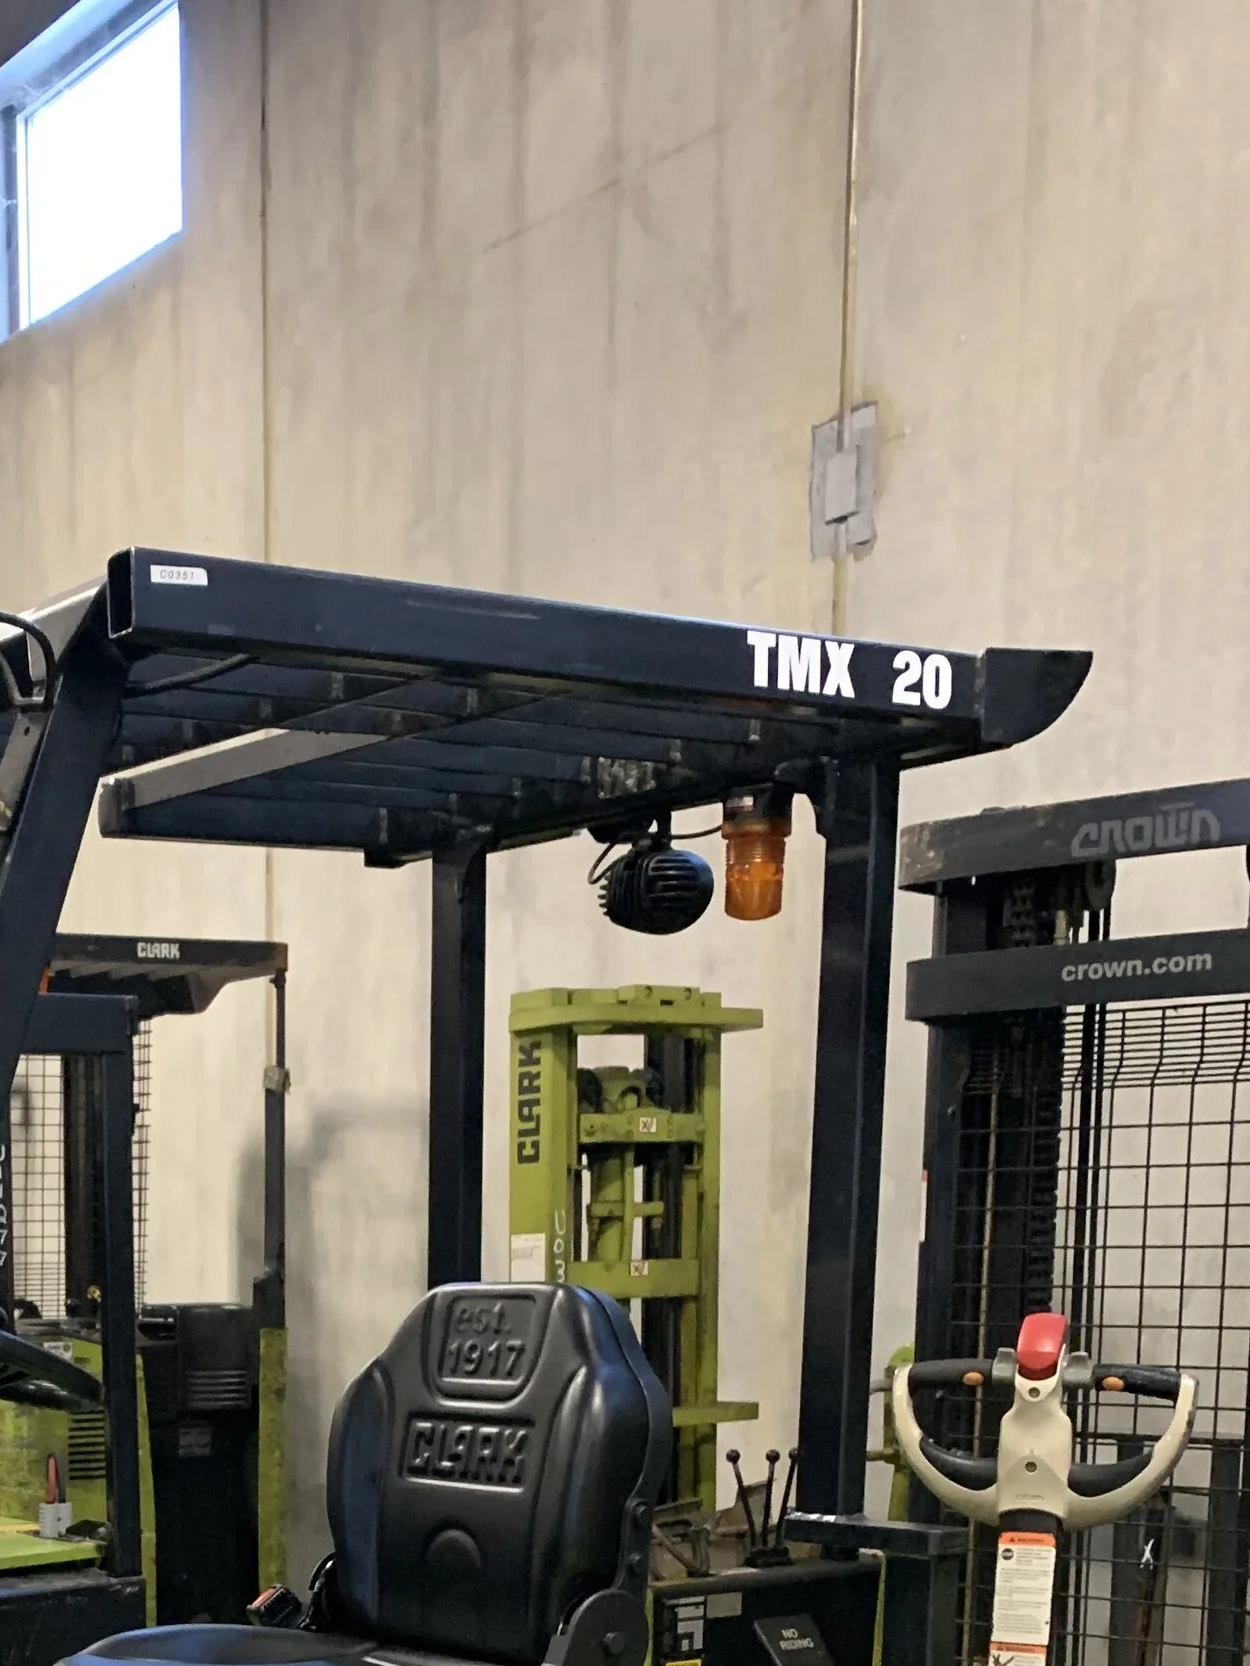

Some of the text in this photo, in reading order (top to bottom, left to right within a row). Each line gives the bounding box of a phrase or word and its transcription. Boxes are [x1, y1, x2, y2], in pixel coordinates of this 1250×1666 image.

[746, 629, 953, 710] TMX 20
[137, 941, 180, 959] CLARK
[1061, 952, 1212, 982] crown.com
[517, 1039, 542, 1165] CLARK
[449, 1339, 526, 1377] 1917
[406, 1420, 529, 1484] CLARK
[779, 1637, 814, 1650] RIDING
[781, 1628, 799, 1639] NO
